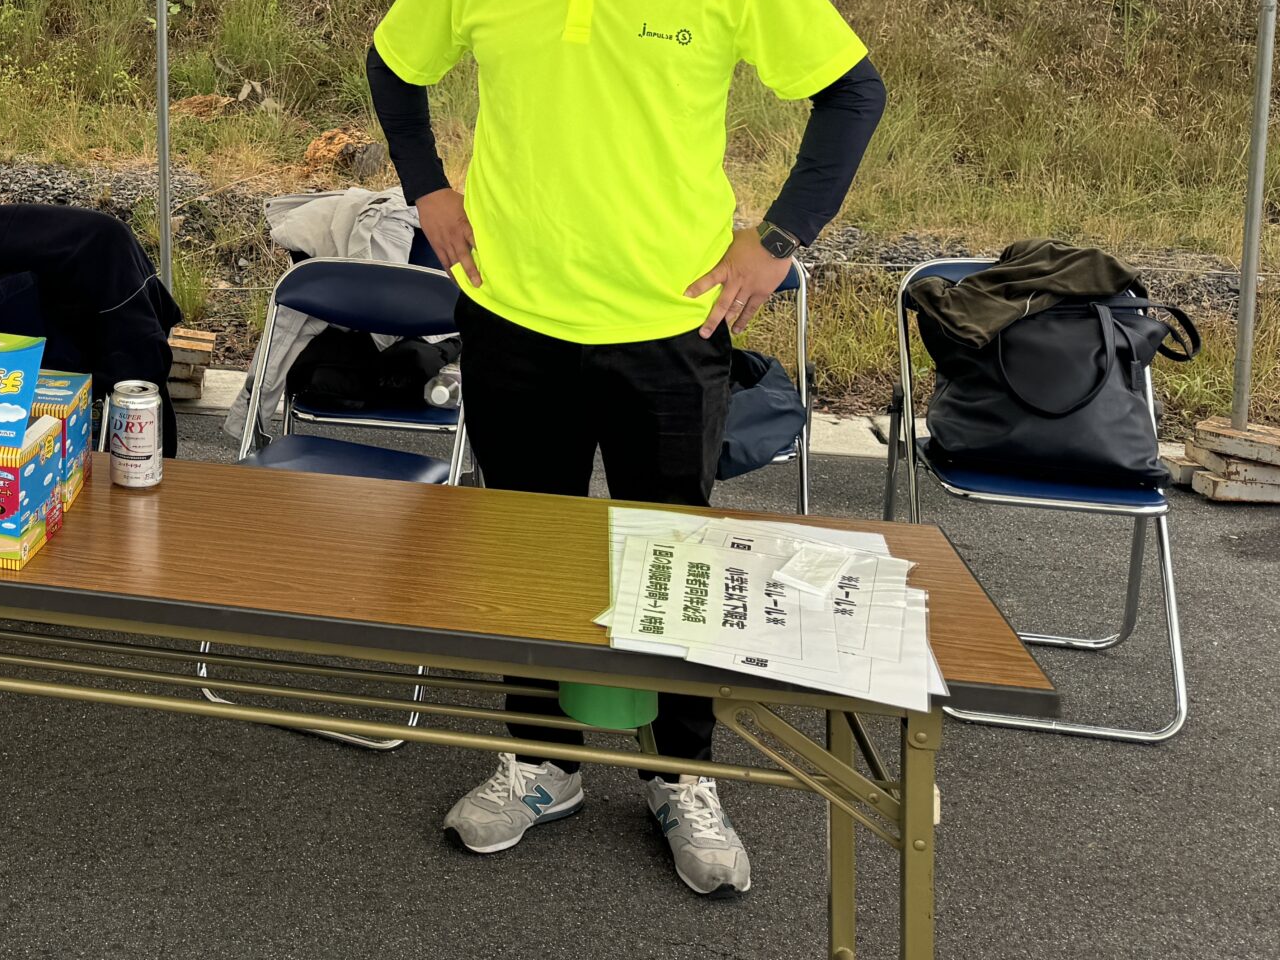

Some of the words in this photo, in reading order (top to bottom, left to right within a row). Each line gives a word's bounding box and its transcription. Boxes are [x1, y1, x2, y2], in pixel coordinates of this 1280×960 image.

[118, 412, 142, 421] SUPER
[681, 561, 711, 624] 保護者同伴必須
[721, 567, 749, 630] 小学生以下限定
